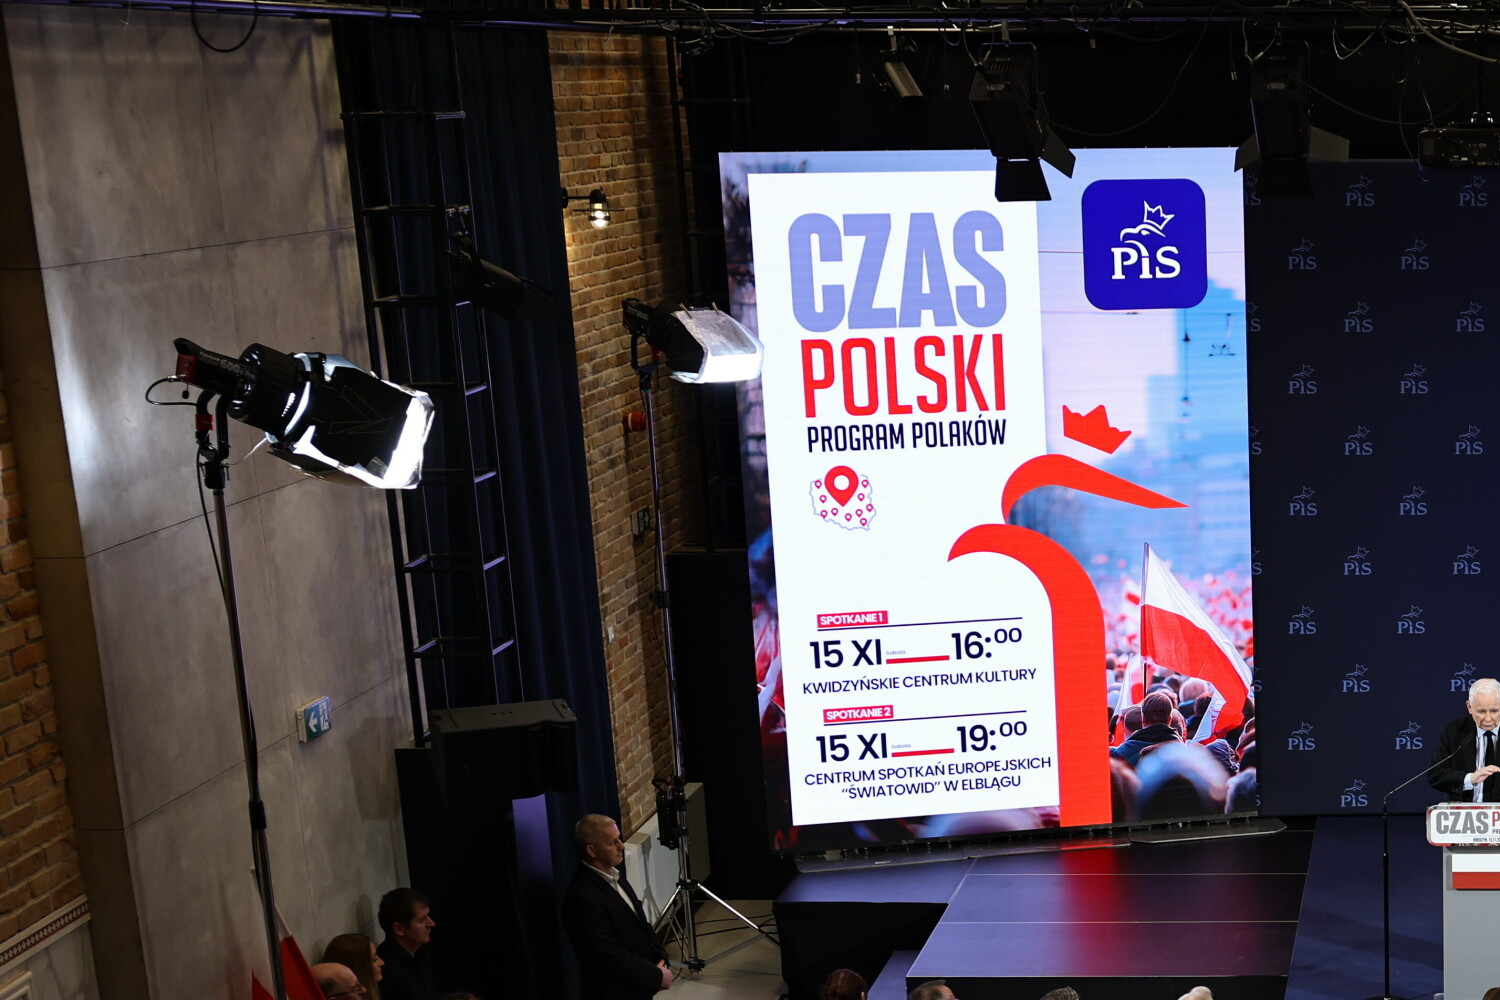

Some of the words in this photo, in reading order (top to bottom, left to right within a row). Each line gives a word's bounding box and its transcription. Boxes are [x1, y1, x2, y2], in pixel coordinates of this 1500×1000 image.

[1346, 191, 1374, 206] PiS
[1459, 190, 1487, 206] PiS
[1111, 246, 1181, 280] PiS
[1288, 254, 1317, 269] PiS
[1401, 254, 1429, 269] PiS
[788, 210, 1007, 332] CZAS
[1345, 317, 1372, 332] PiS
[1456, 316, 1484, 332] PiS
[801, 333, 1006, 418] POLSKI
[1289, 379, 1317, 394] PiS
[1400, 379, 1428, 393] PiS
[807, 419, 905, 453] PROGRAM
[911, 413, 1007, 450] POLAKÓW
[1345, 440, 1372, 455] PiS
[1455, 439, 1483, 454] PiS
[1290, 501, 1317, 515] PiS
[1400, 500, 1427, 515] PiS
[1344, 560, 1371, 575] PiS
[1453, 560, 1480, 574] PiS
[819, 613, 877, 626] SPOTKANIE
[878, 612, 884, 623] 1
[1398, 619, 1425, 633] PiS
[1289, 620, 1316, 634] PiS
[809, 640, 844, 669] 15
[853, 639, 882, 666] XI
[803, 675, 900, 694] KWIDZYŃSKIE
[903, 673, 973, 688] CENTRUM
[975, 668, 1037, 683] KULTURY
[1343, 678, 1370, 692] PiS
[826, 708, 883, 720] SPOTKANIE
[884, 707, 891, 717] 2
[816, 734, 850, 763] 15
[858, 733, 888, 760] XI
[1288, 736, 1315, 750] PiS
[1395, 735, 1422, 749] PiS
[804, 768, 875, 786] CENTRUM
[878, 761, 946, 781] SPOTKAŃ
[948, 757, 1051, 776] EUROPEJSKICH
[944, 778, 958, 792] W
[961, 775, 1021, 792] ELBLĄGU
[1341, 793, 1367, 807] PiS
[1436, 811, 1489, 834] CZAS
